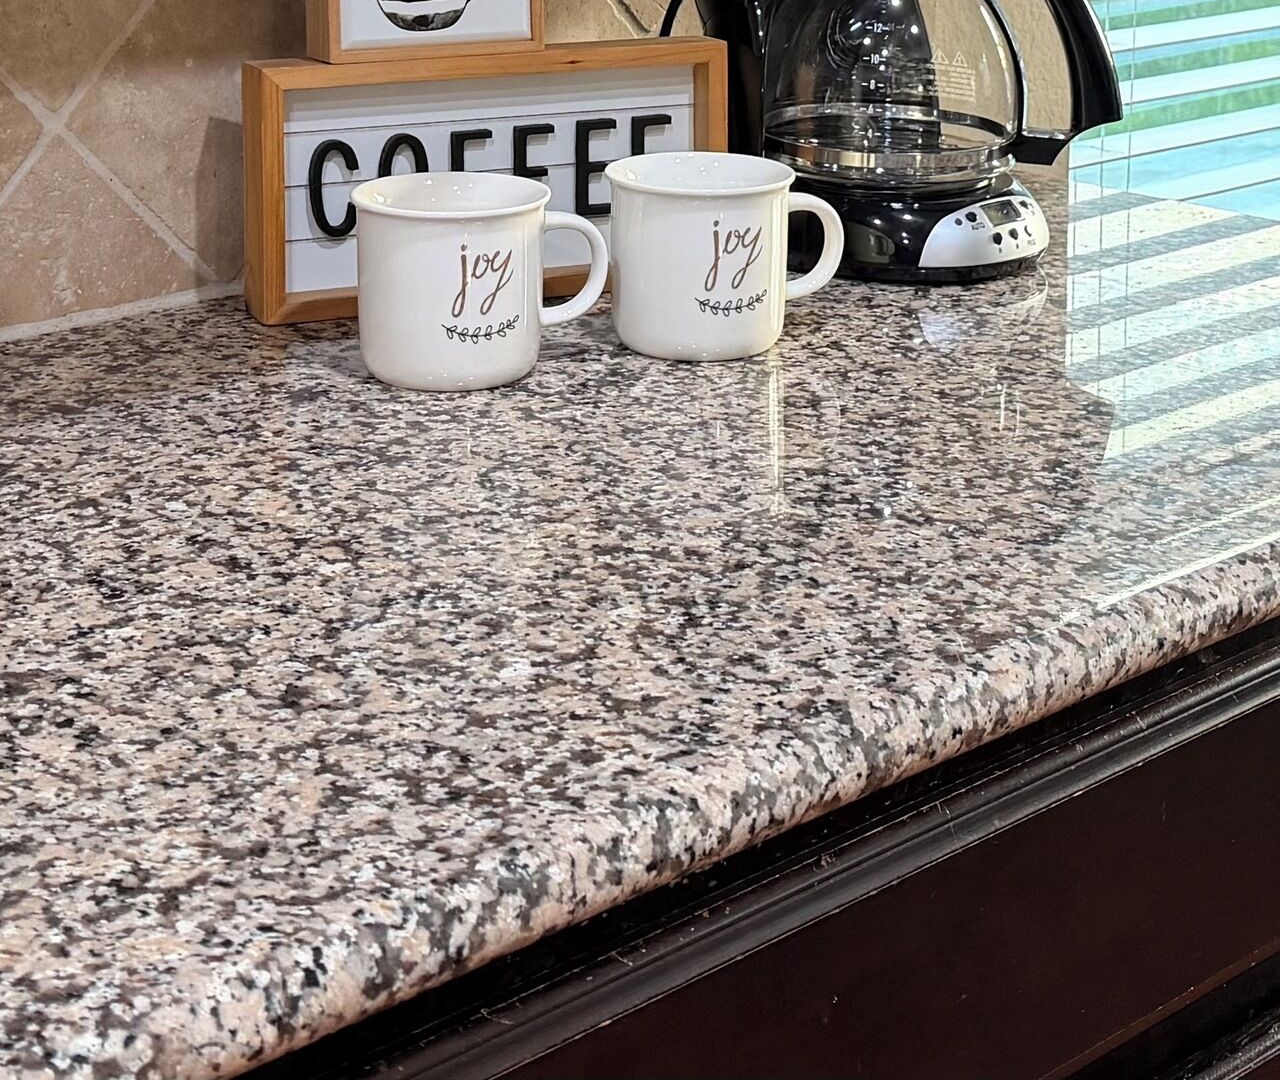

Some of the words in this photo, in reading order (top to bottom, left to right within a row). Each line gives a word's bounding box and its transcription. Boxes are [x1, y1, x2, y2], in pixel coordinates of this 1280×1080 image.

[873, 23, 883, 33] 12
[870, 53, 880, 64] 10
[869, 79, 876, 90] 8
[866, 128, 873, 139] 4
[704, 220, 763, 291] joy
[451, 242, 514, 317] joy
